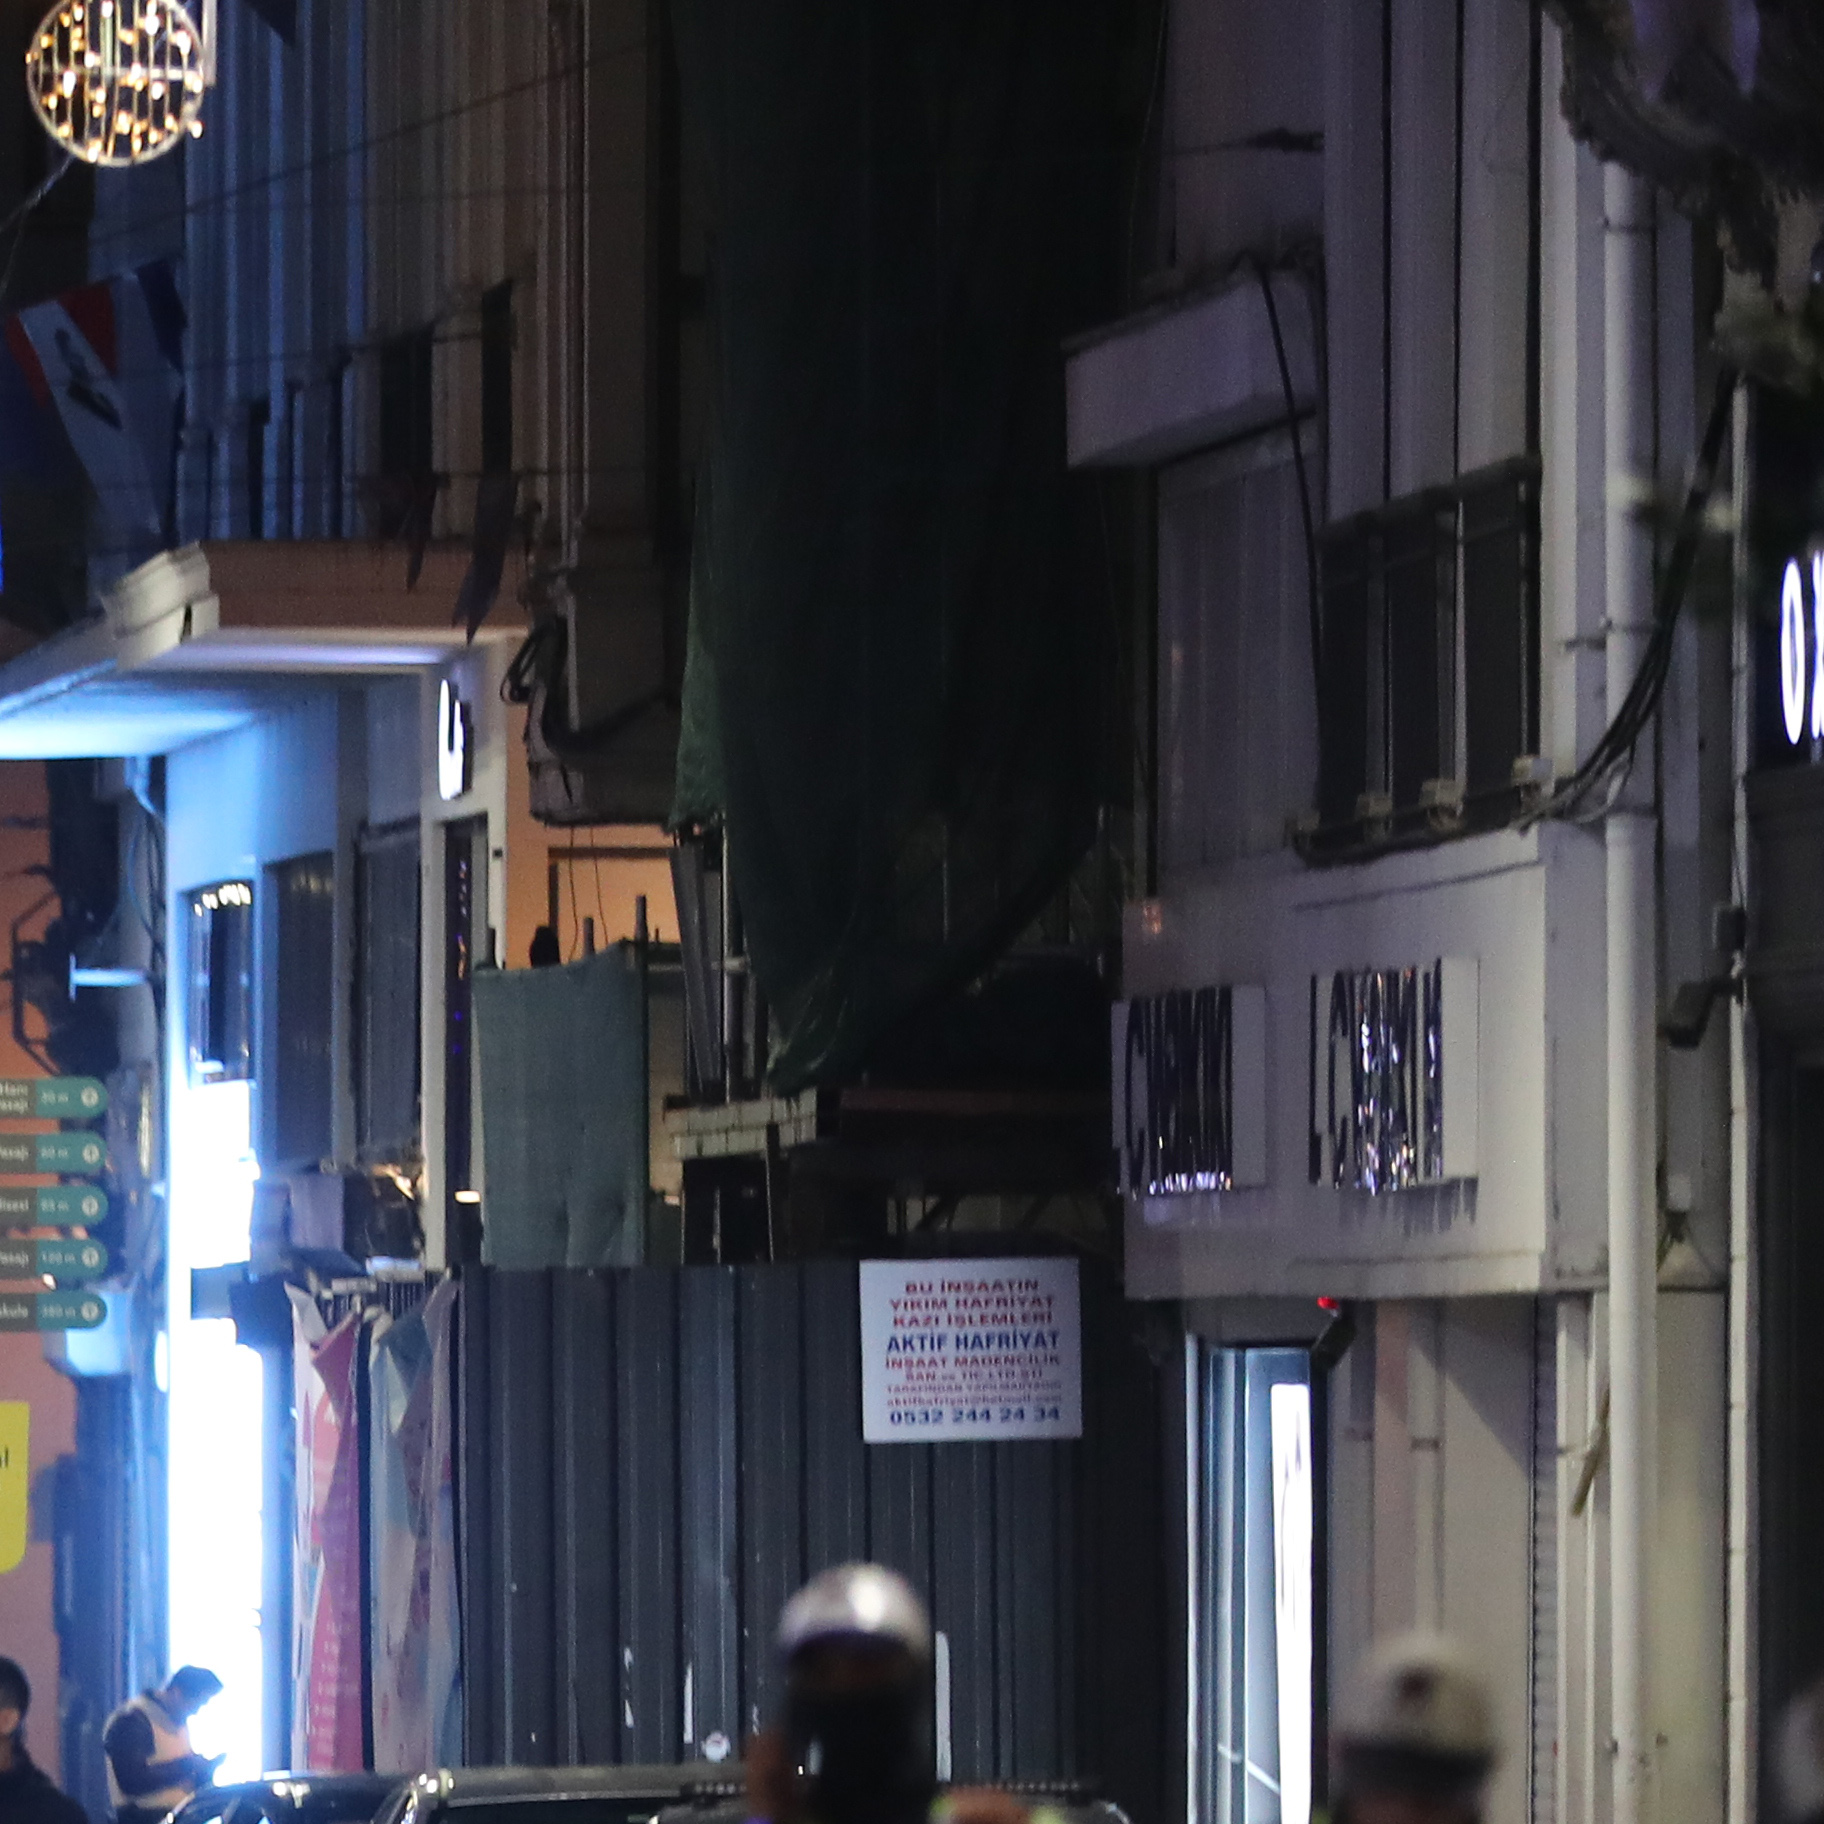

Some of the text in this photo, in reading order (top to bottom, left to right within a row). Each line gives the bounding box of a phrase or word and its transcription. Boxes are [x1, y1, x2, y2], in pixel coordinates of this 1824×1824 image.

[905, 1280, 933, 1294] BU
[887, 1328, 1060, 1352] AKTİF HAFRİYAT
